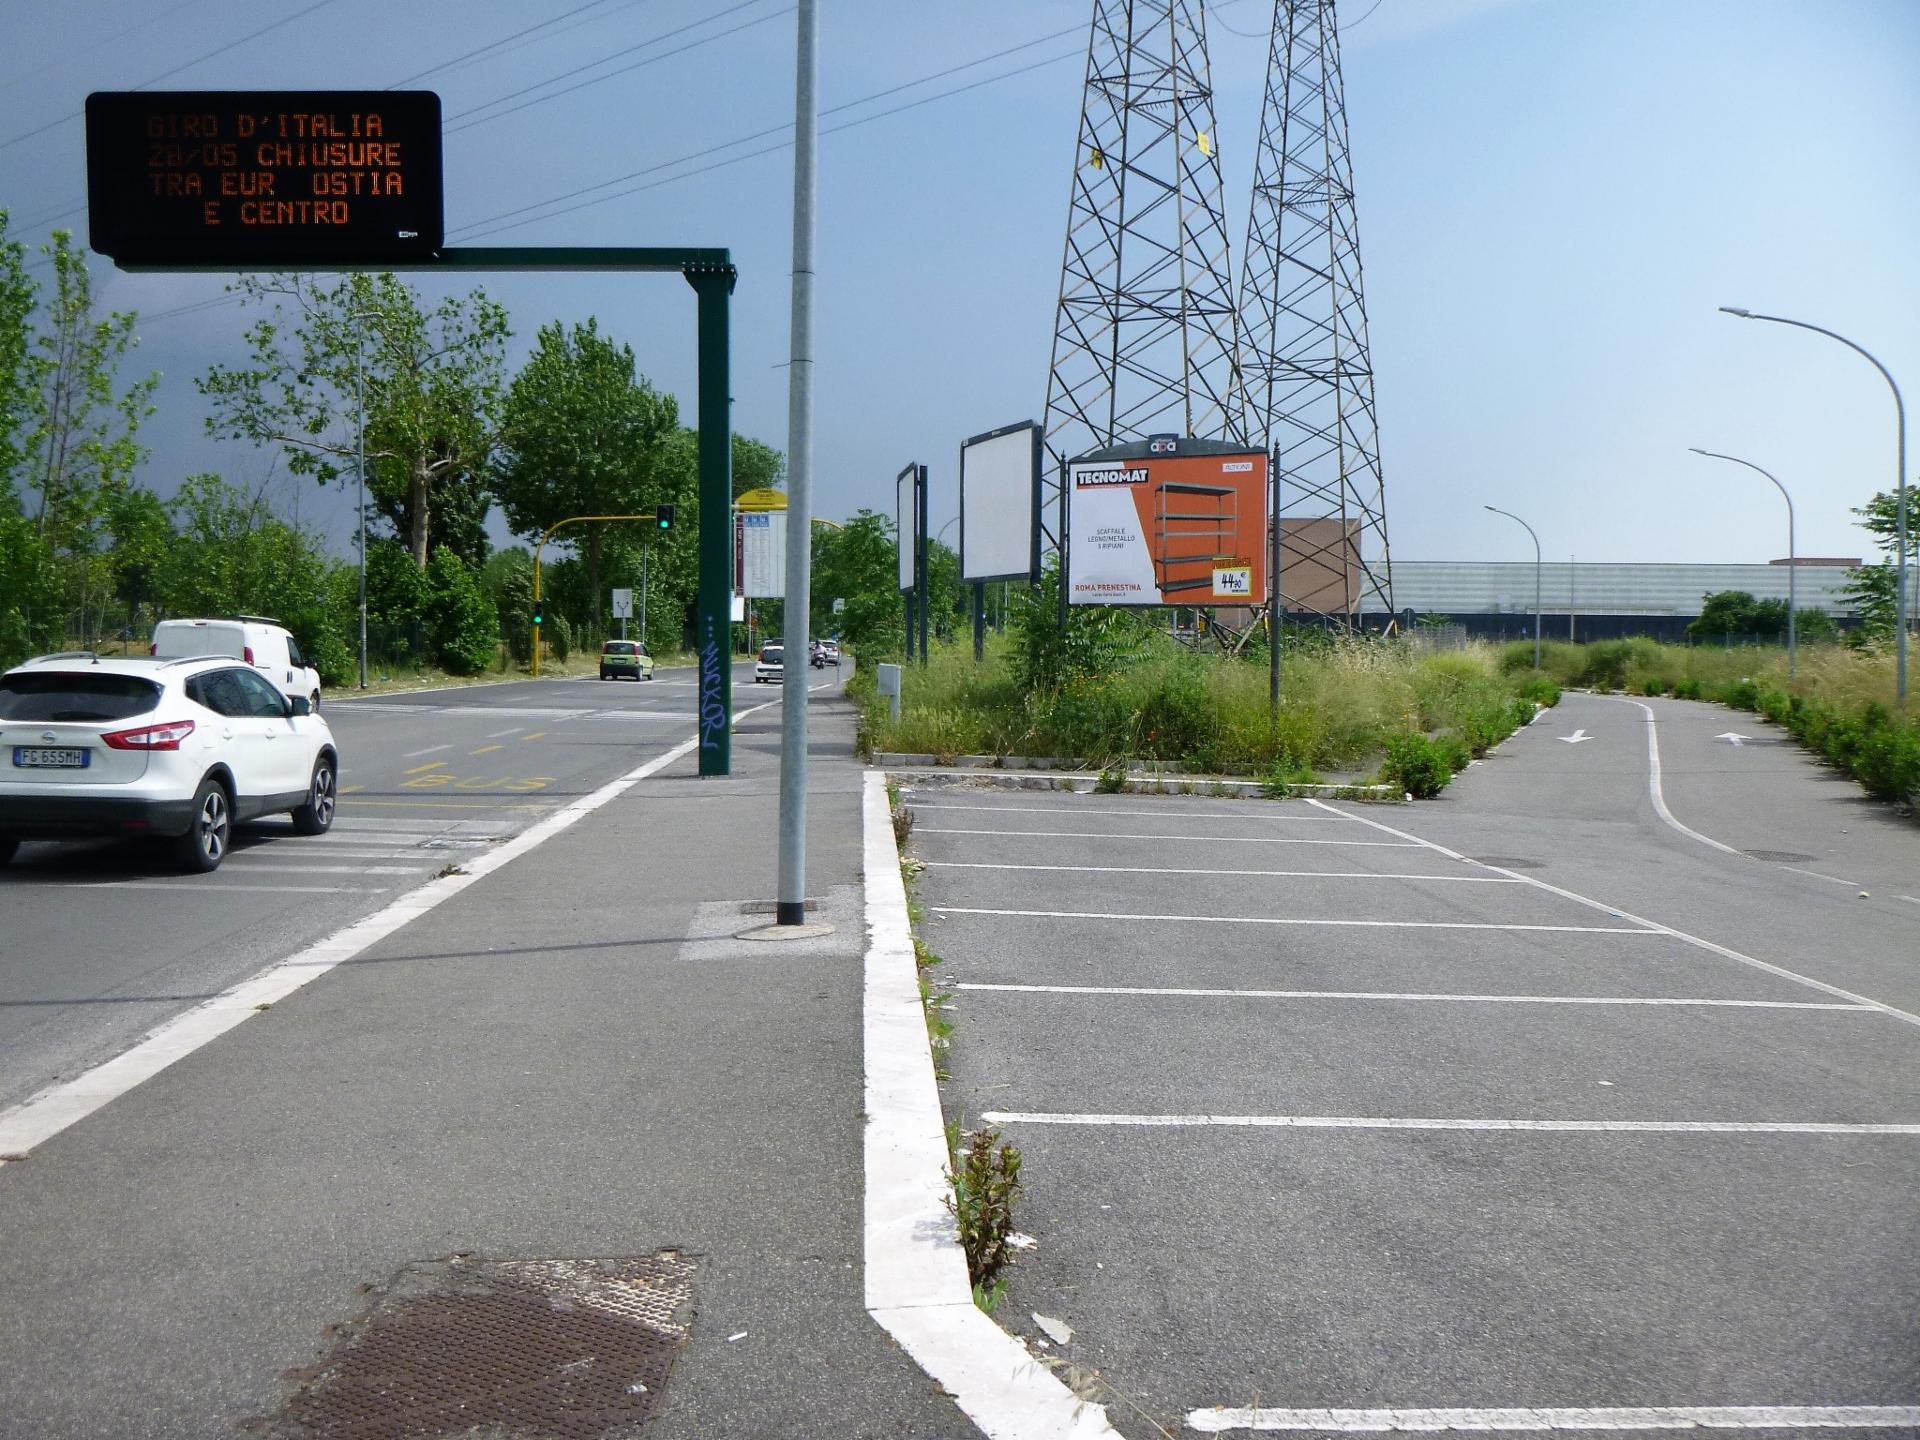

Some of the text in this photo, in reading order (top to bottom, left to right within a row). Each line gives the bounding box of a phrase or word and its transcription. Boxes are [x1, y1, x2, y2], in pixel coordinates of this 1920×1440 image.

[147, 112, 383, 138] GIRO D'ITALIA
[257, 142, 402, 167] CHIUSURE
[149, 171, 403, 196] TRA EUR OSTIA
[204, 200, 348, 225] E CENTRO
[1078, 469, 1148, 485] TECNOMAT
[1087, 535, 1136, 543] LEGNO/METALLO
[1096, 527, 1126, 535] SCAFFALE
[1075, 583, 1142, 592] ROMA PRENESTINA
[41, 750, 82, 764] 655MH
[399, 774, 557, 790] BUS
